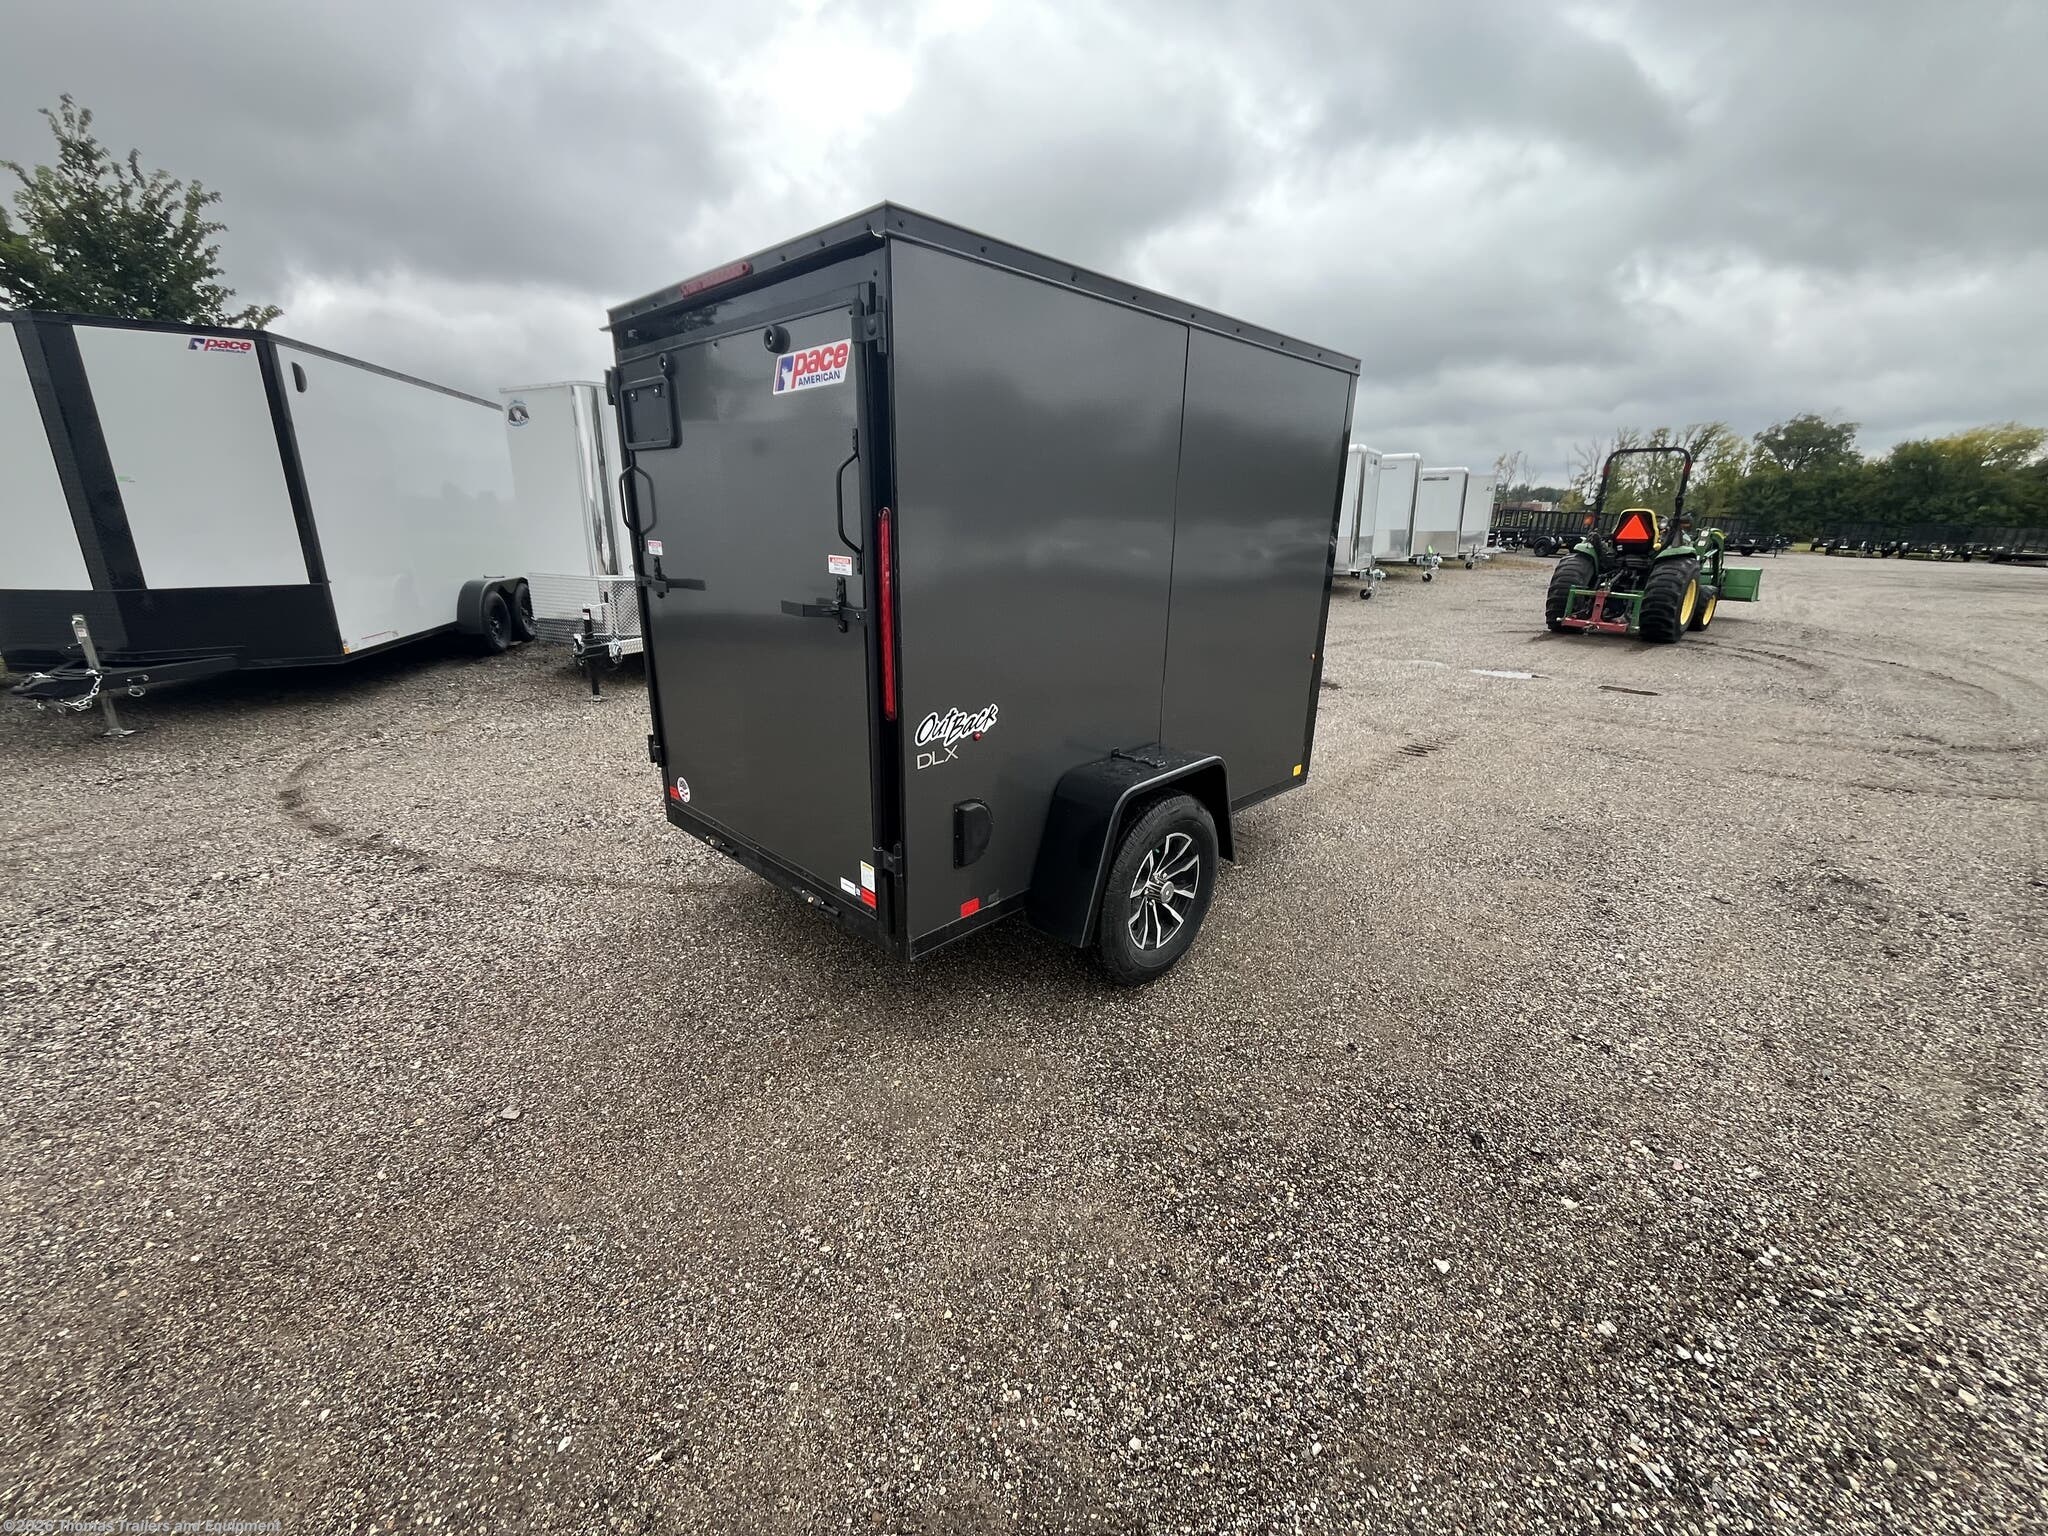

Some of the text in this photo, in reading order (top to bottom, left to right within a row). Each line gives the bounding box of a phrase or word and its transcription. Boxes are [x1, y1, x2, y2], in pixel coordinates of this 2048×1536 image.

[203, 339, 252, 352] pace
[791, 343, 849, 389] pace
[798, 370, 841, 387] AMERICAN
[915, 704, 999, 747] OutBack
[917, 745, 959, 770] DLX
